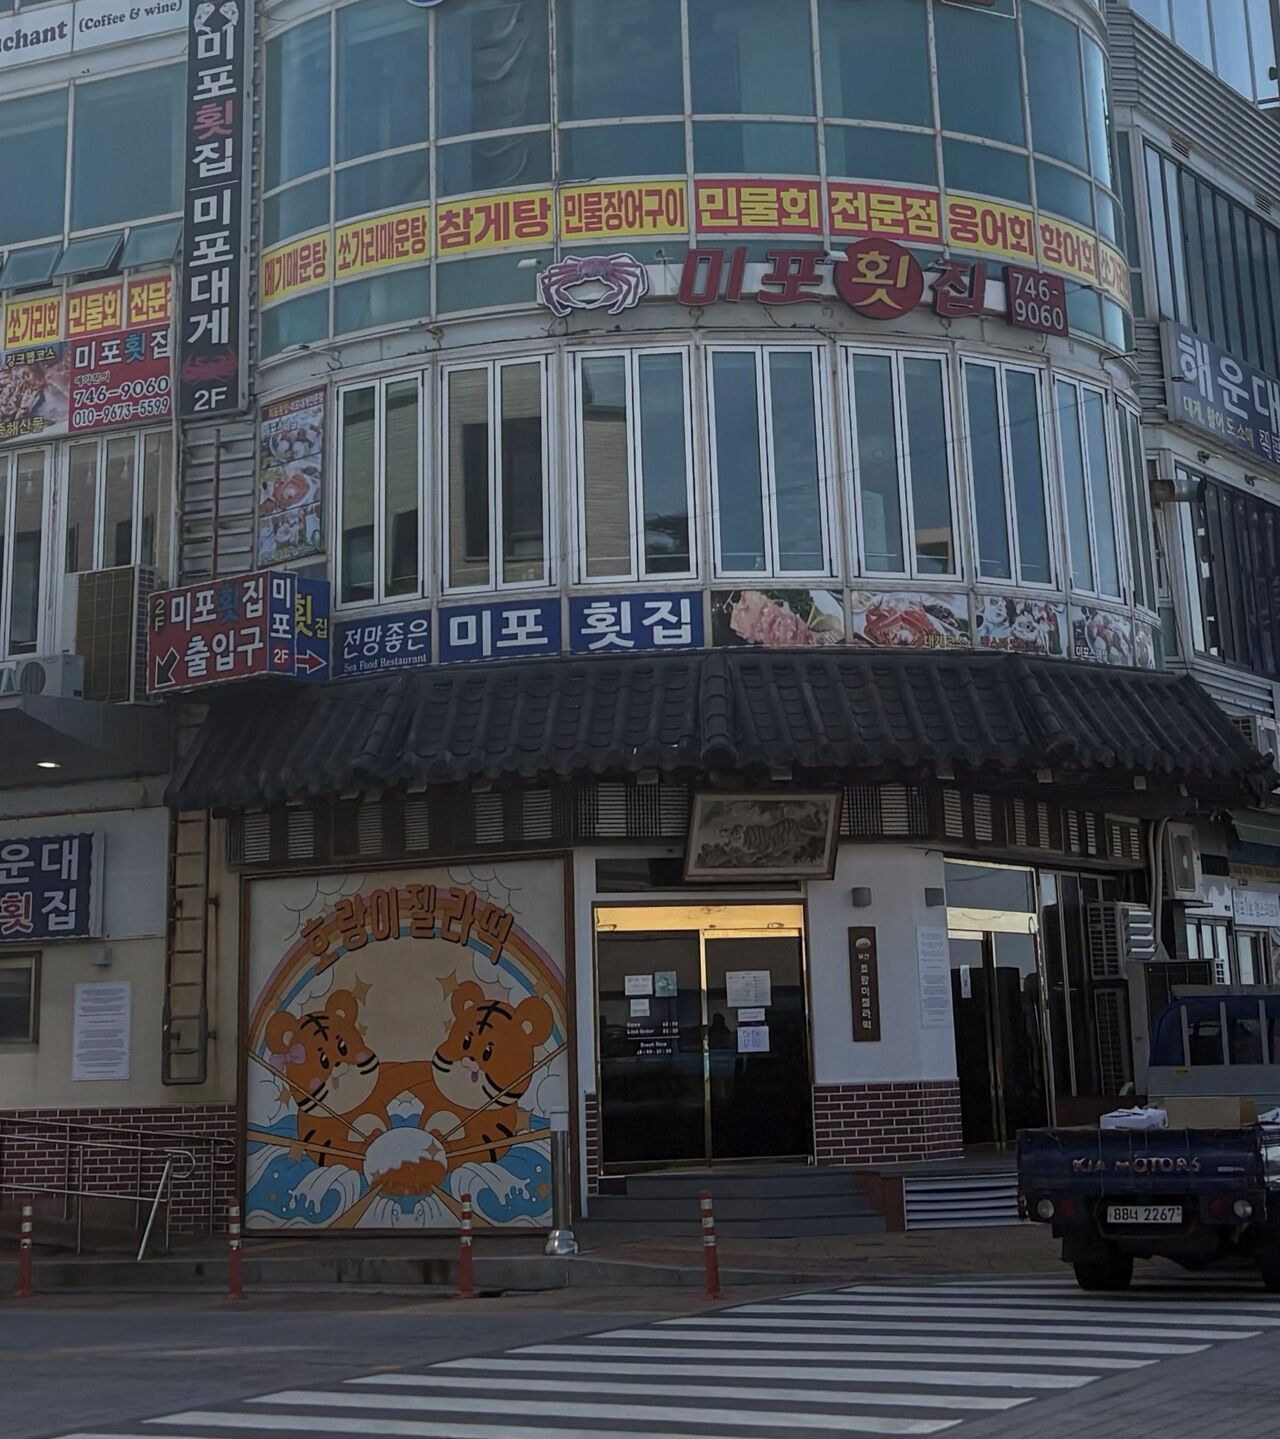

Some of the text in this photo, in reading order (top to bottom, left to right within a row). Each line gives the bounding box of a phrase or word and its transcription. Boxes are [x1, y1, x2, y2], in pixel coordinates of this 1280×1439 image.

[79, 12, 126, 33] (Coffee
[129, 7, 141, 20] &
[191, 25, 237, 179] 미포횟집
[264, 239, 327, 297] 메기매운탕
[338, 215, 427, 271] 쏘가리매운탕
[439, 195, 553, 251] 참게탕
[563, 182, 686, 236] 민물장어구이
[697, 182, 820, 231] 민물회
[830, 192, 941, 239] 전문점
[948, 203, 1035, 257] 웅어회
[1040, 223, 1099, 280] 향어회
[187, 188, 234, 345] 미포대게
[677, 242, 988, 320] 미포횟집
[1011, 272, 1060, 302] 746-
[8, 300, 60, 343] 쏘가리회
[69, 288, 121, 334] 민물회
[130, 279, 172, 323] 전문
[1014, 298, 1064, 331] 9060
[74, 326, 170, 370] 미포횟집
[72, 396, 170, 427] 010-9673-5599
[74, 376, 170, 407] 746-9060
[193, 386, 228, 411] 2F
[170, 576, 265, 631] 미포횟집
[271, 577, 293, 640] 미포
[343, 618, 429, 659] 전망좋은
[448, 596, 694, 658] 미포 횟집
[184, 626, 265, 677] 출입구
[273, 648, 290, 664] 2F
[359, 659, 379, 672] Food
[380, 653, 428, 669] Restaurant
[300, 883, 515, 977] 호랑이젤라떡
[1072, 1156, 1106, 1172] KIA
[1144, 1207, 1175, 1221] 2267
